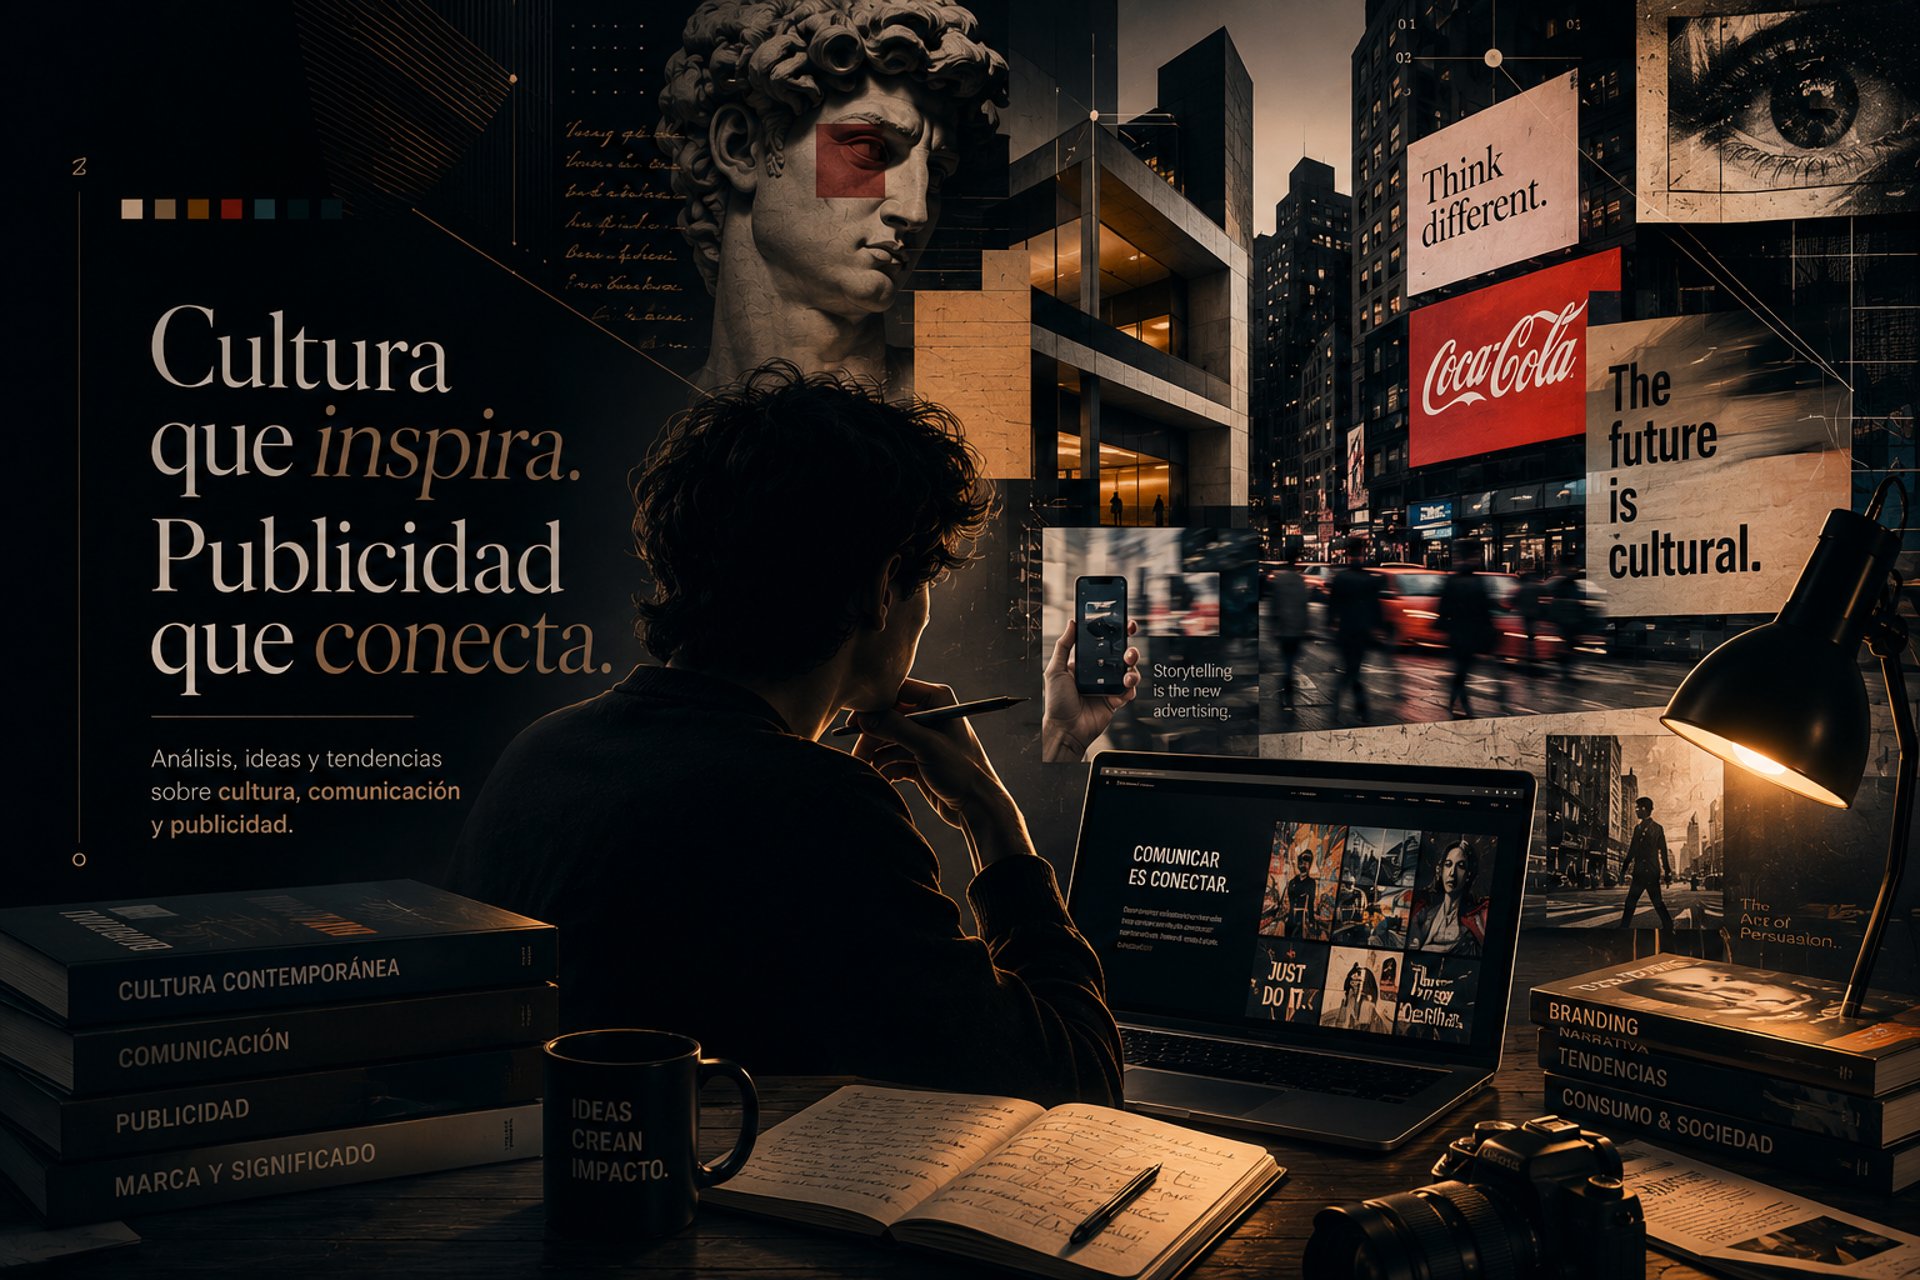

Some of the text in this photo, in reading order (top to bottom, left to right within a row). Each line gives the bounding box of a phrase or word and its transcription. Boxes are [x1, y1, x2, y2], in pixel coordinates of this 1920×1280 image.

[1422, 145, 1504, 205] Think
[1421, 177, 1548, 249] different.
[1422, 298, 1588, 416] Coca-Cola
[1608, 361, 1671, 412] The
[1608, 419, 1718, 469] future
[1609, 477, 1638, 524] is
[1608, 523, 1762, 580] cultural.
[1153, 663, 1234, 682] Storytelling
[1153, 683, 1223, 698] is the new
[1153, 702, 1232, 721] advertising.
[1132, 844, 1221, 869] COMUNICAR
[1128, 868, 1230, 894] ES CONECTAR.
[118, 955, 400, 1001] CULTURA CONTEMPORÁNEA
[1267, 961, 1307, 983] JUST
[1262, 986, 1285, 1008] DO
[1549, 1002, 1639, 1036] BRANDING
[118, 1027, 290, 1068] COMUNICACIÓN
[1559, 1027, 1650, 1055] NARRATIVA
[1558, 1047, 1669, 1088] TENDENCIAS
[116, 1098, 250, 1134] PUBLICIDAD
[571, 1098, 632, 1122] IDEAS
[1561, 1088, 1774, 1155] CONSUMO & SOCIEDAD
[571, 1128, 643, 1152] CREAN
[115, 1142, 377, 1198] MARCA Y SIGNIFICADO
[571, 1157, 669, 1182] IMPACTO.
